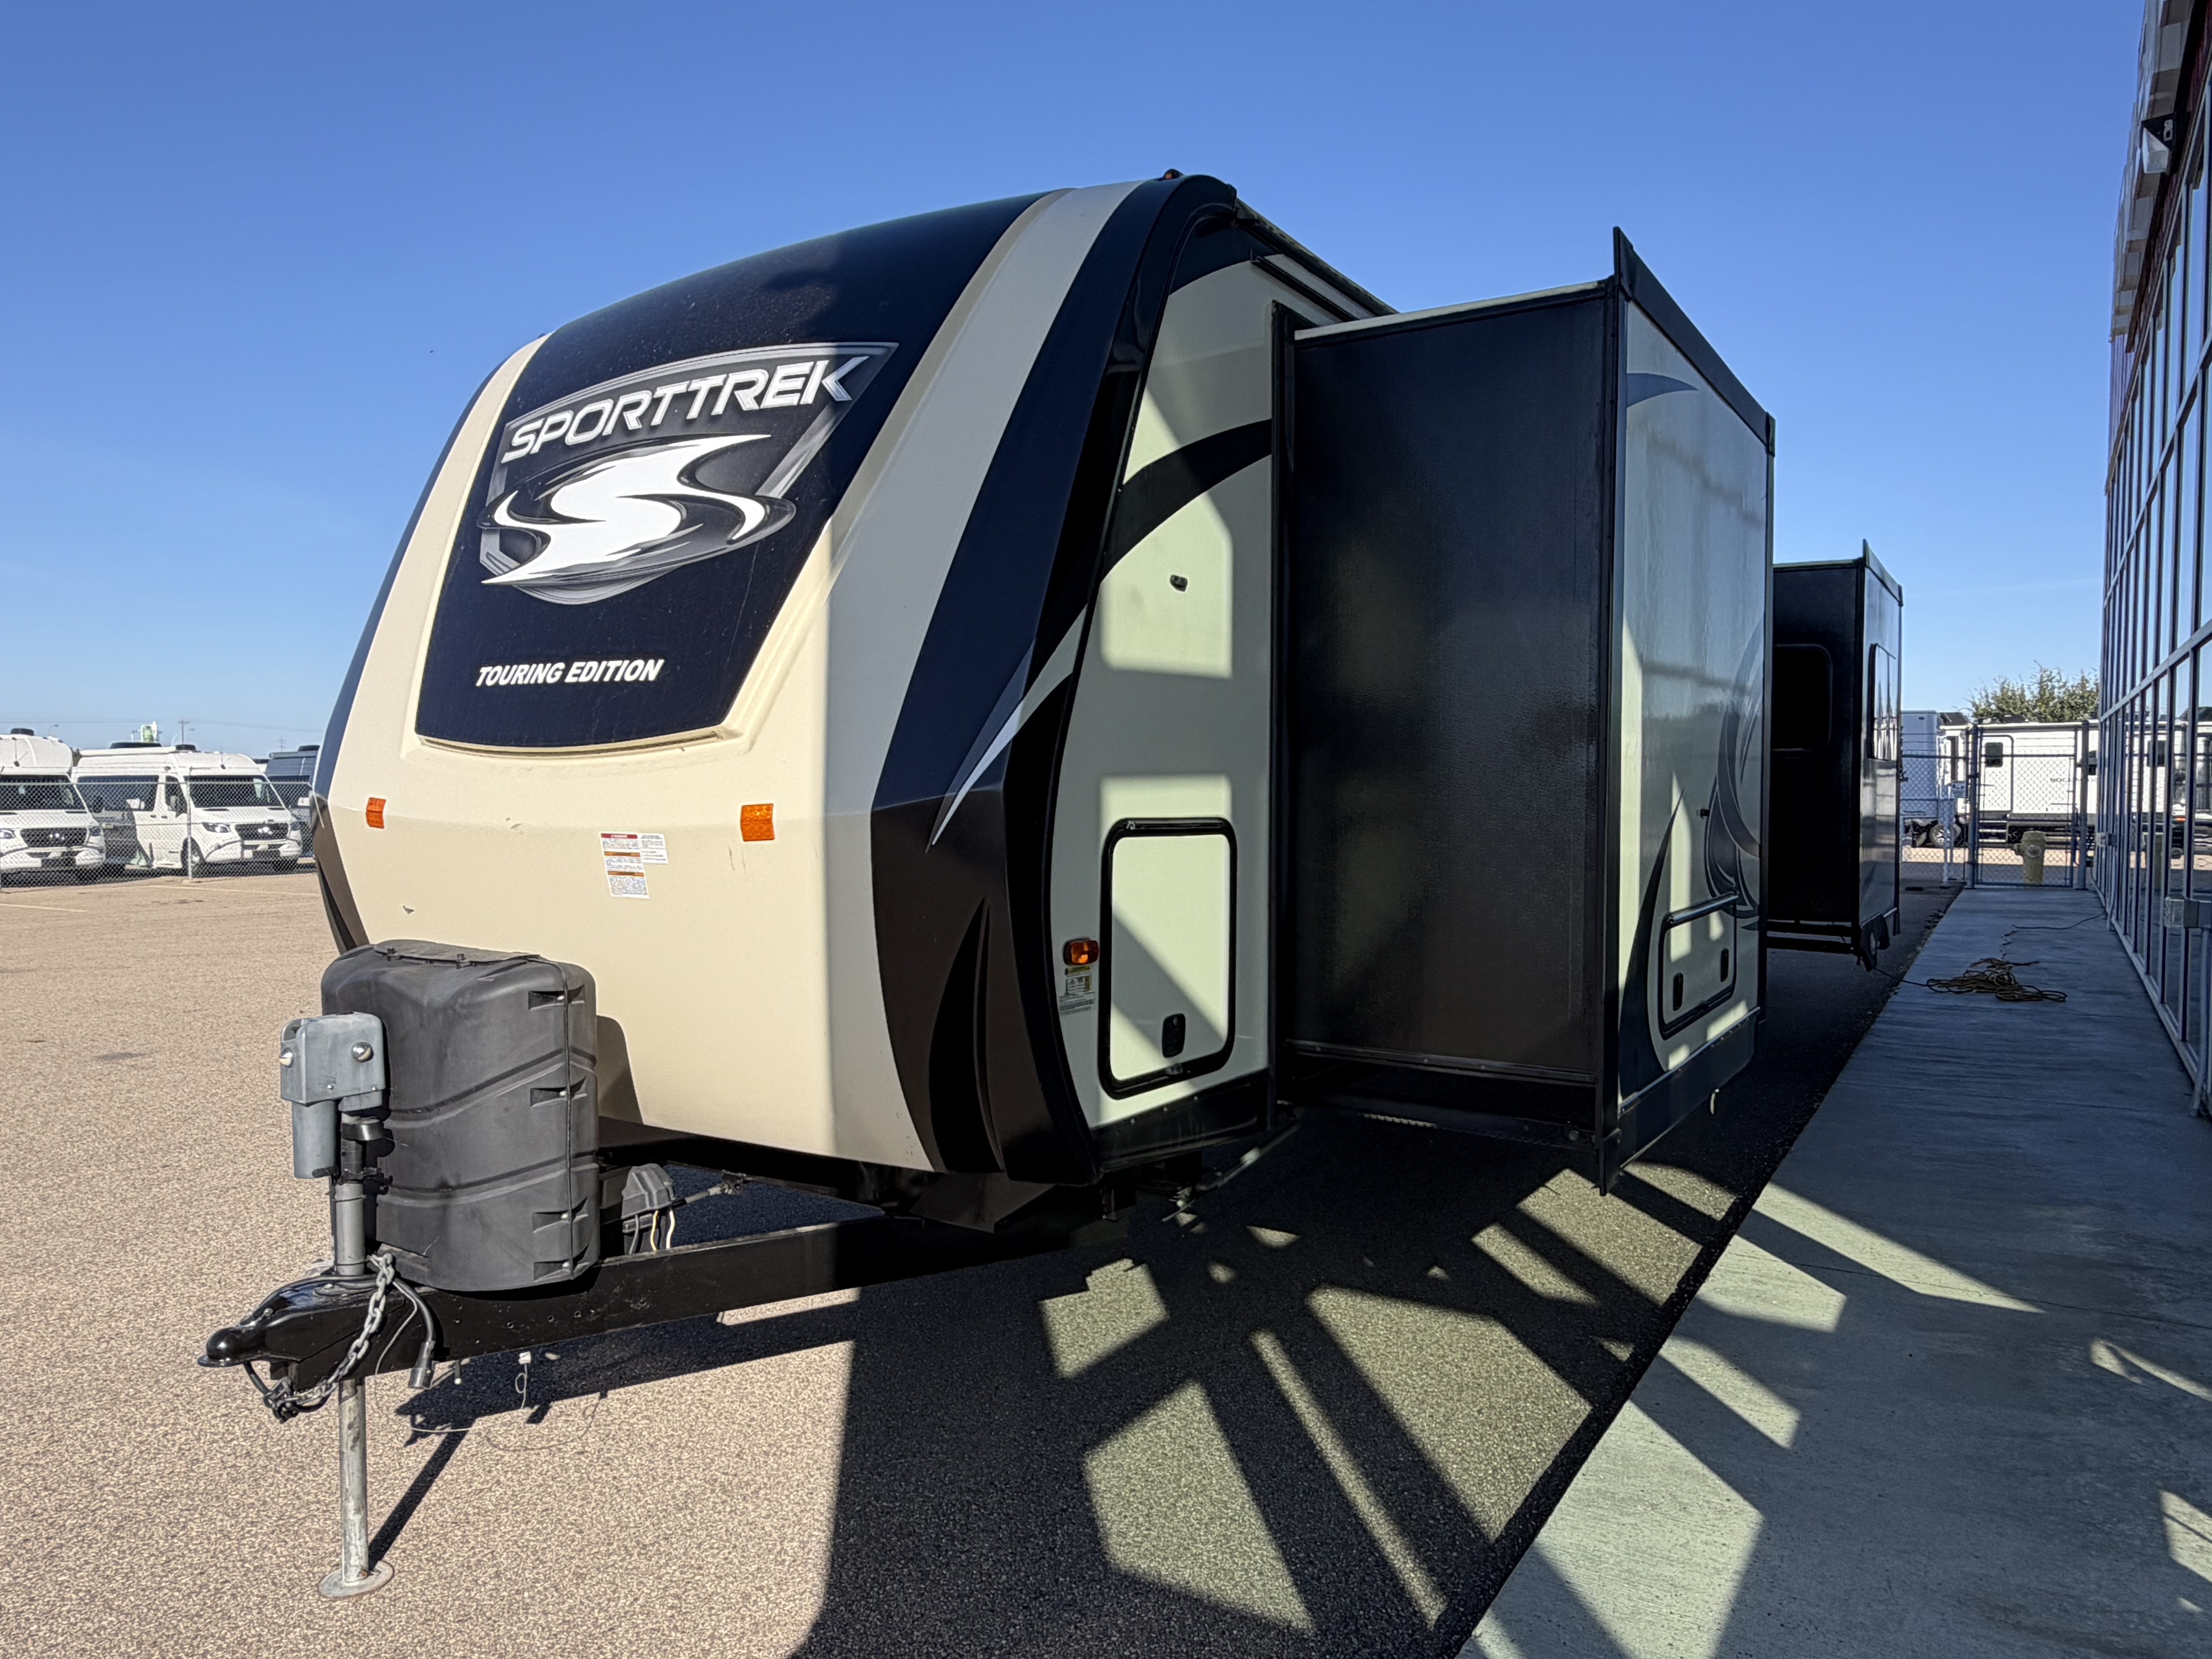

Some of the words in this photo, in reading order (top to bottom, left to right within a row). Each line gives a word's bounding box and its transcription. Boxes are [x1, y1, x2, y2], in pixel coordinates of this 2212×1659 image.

[501, 356, 870, 464] SPORTTREK
[476, 662, 565, 687] TOURING
[564, 659, 665, 683] EDITION
